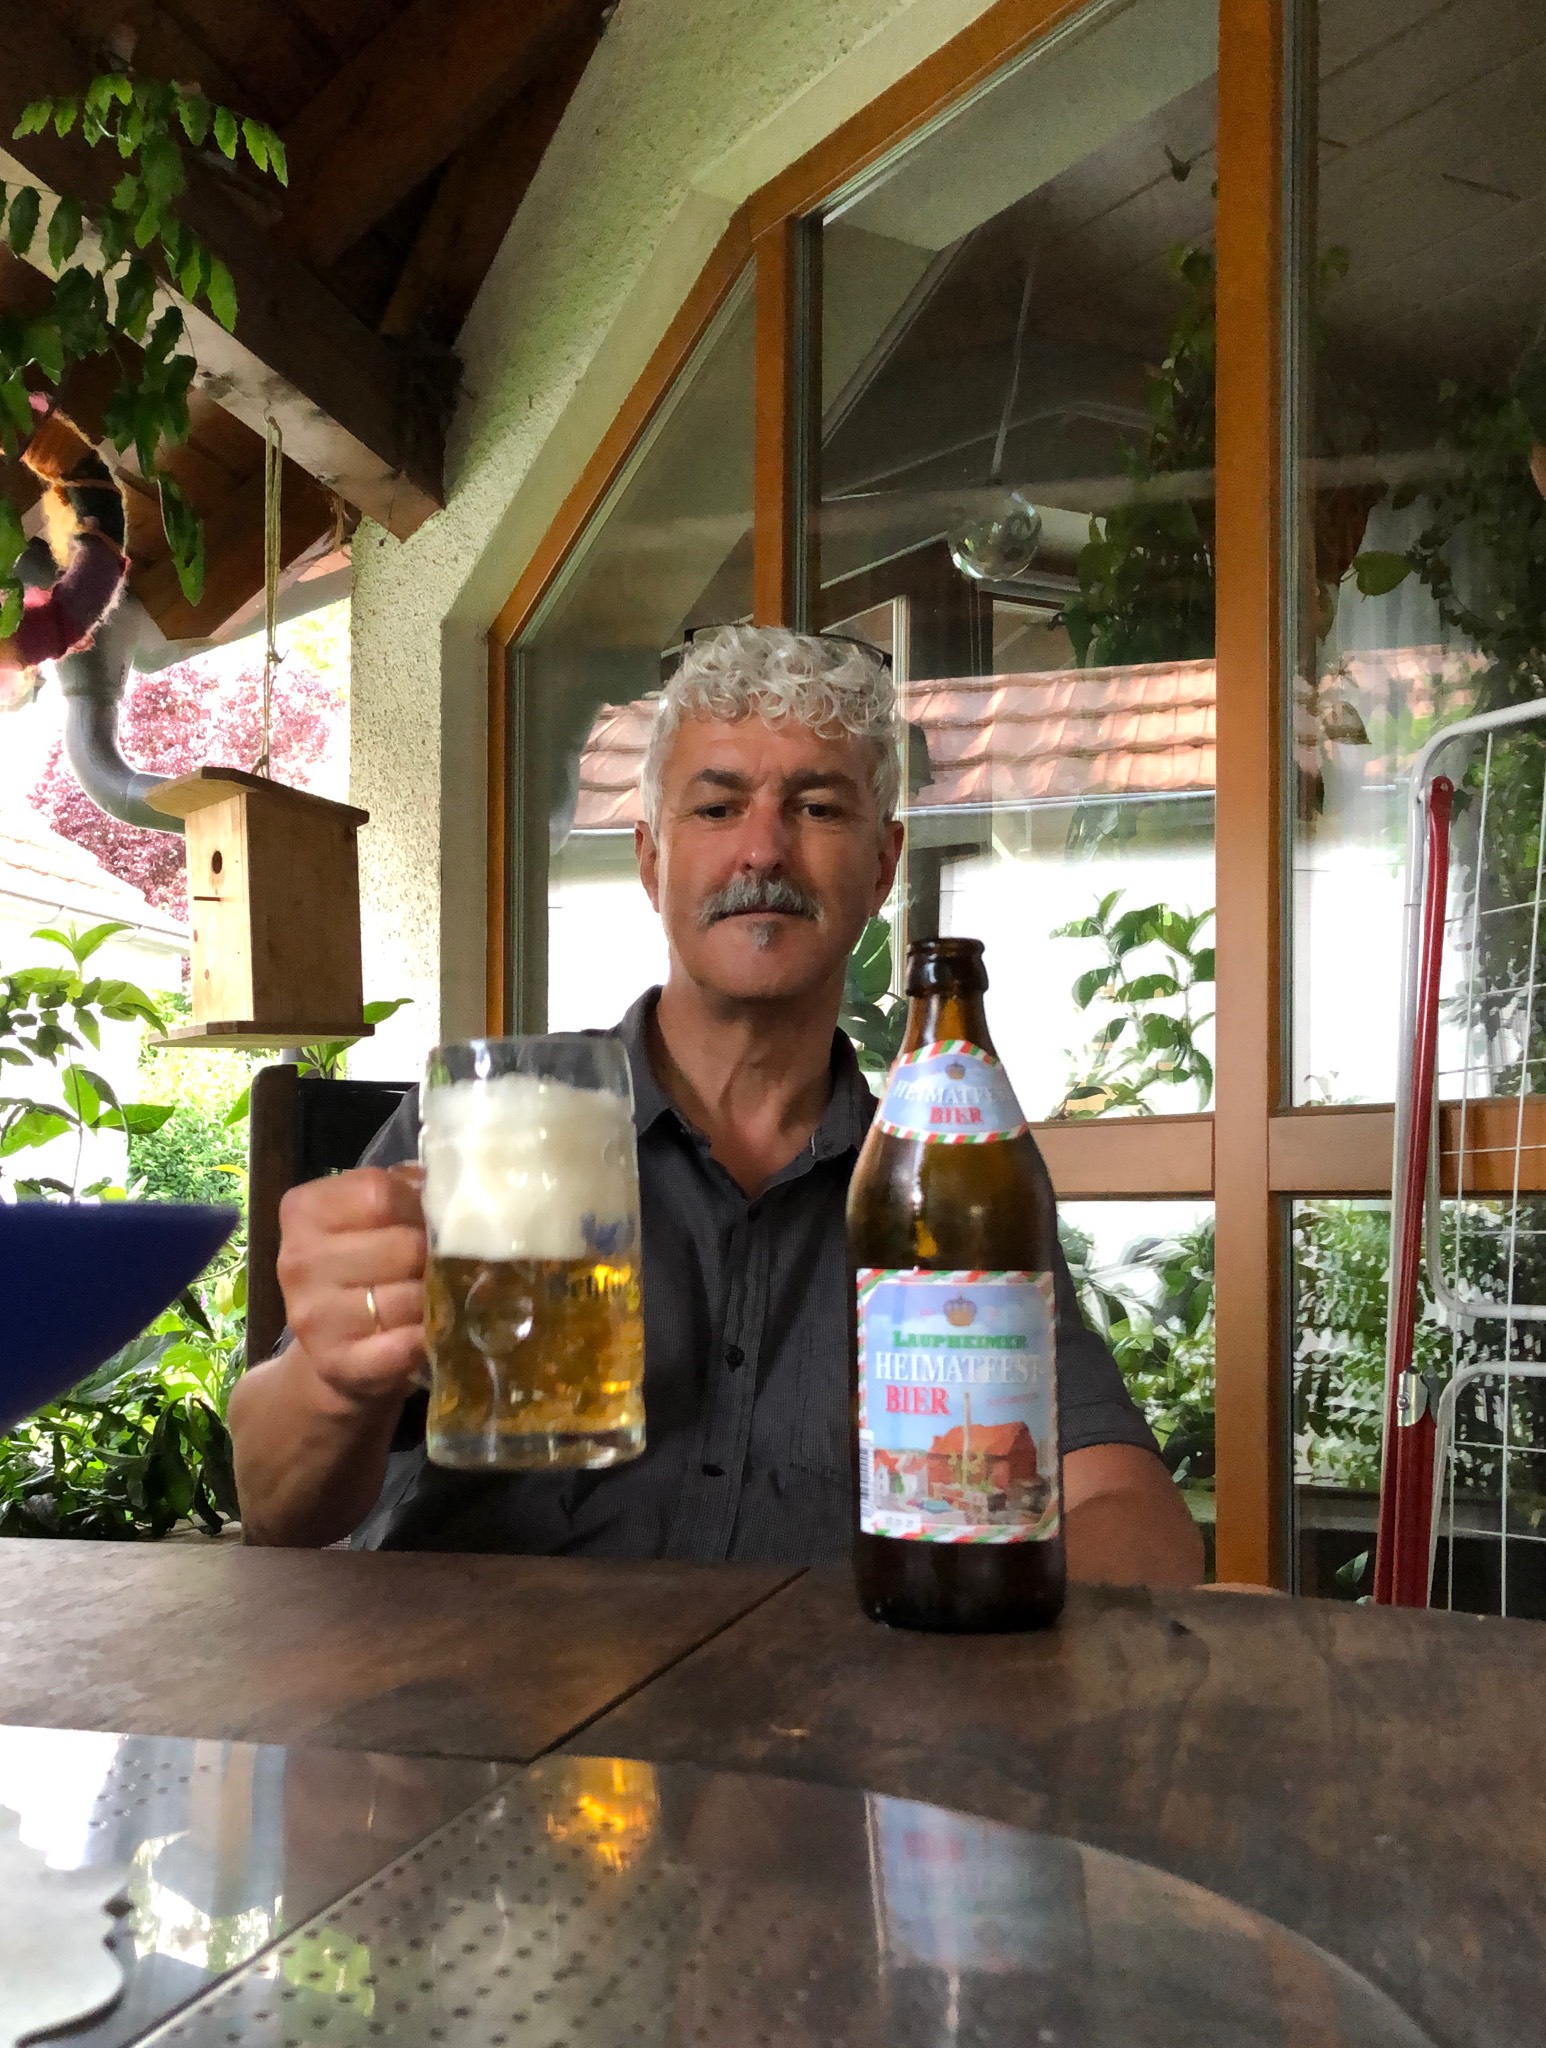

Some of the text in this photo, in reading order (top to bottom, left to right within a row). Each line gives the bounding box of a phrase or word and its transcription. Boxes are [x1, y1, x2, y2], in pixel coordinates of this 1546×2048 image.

[930, 1107, 983, 1124] BIER
[875, 1352, 1041, 1383] HEIMATFEST
[885, 1385, 950, 1415] BIER
